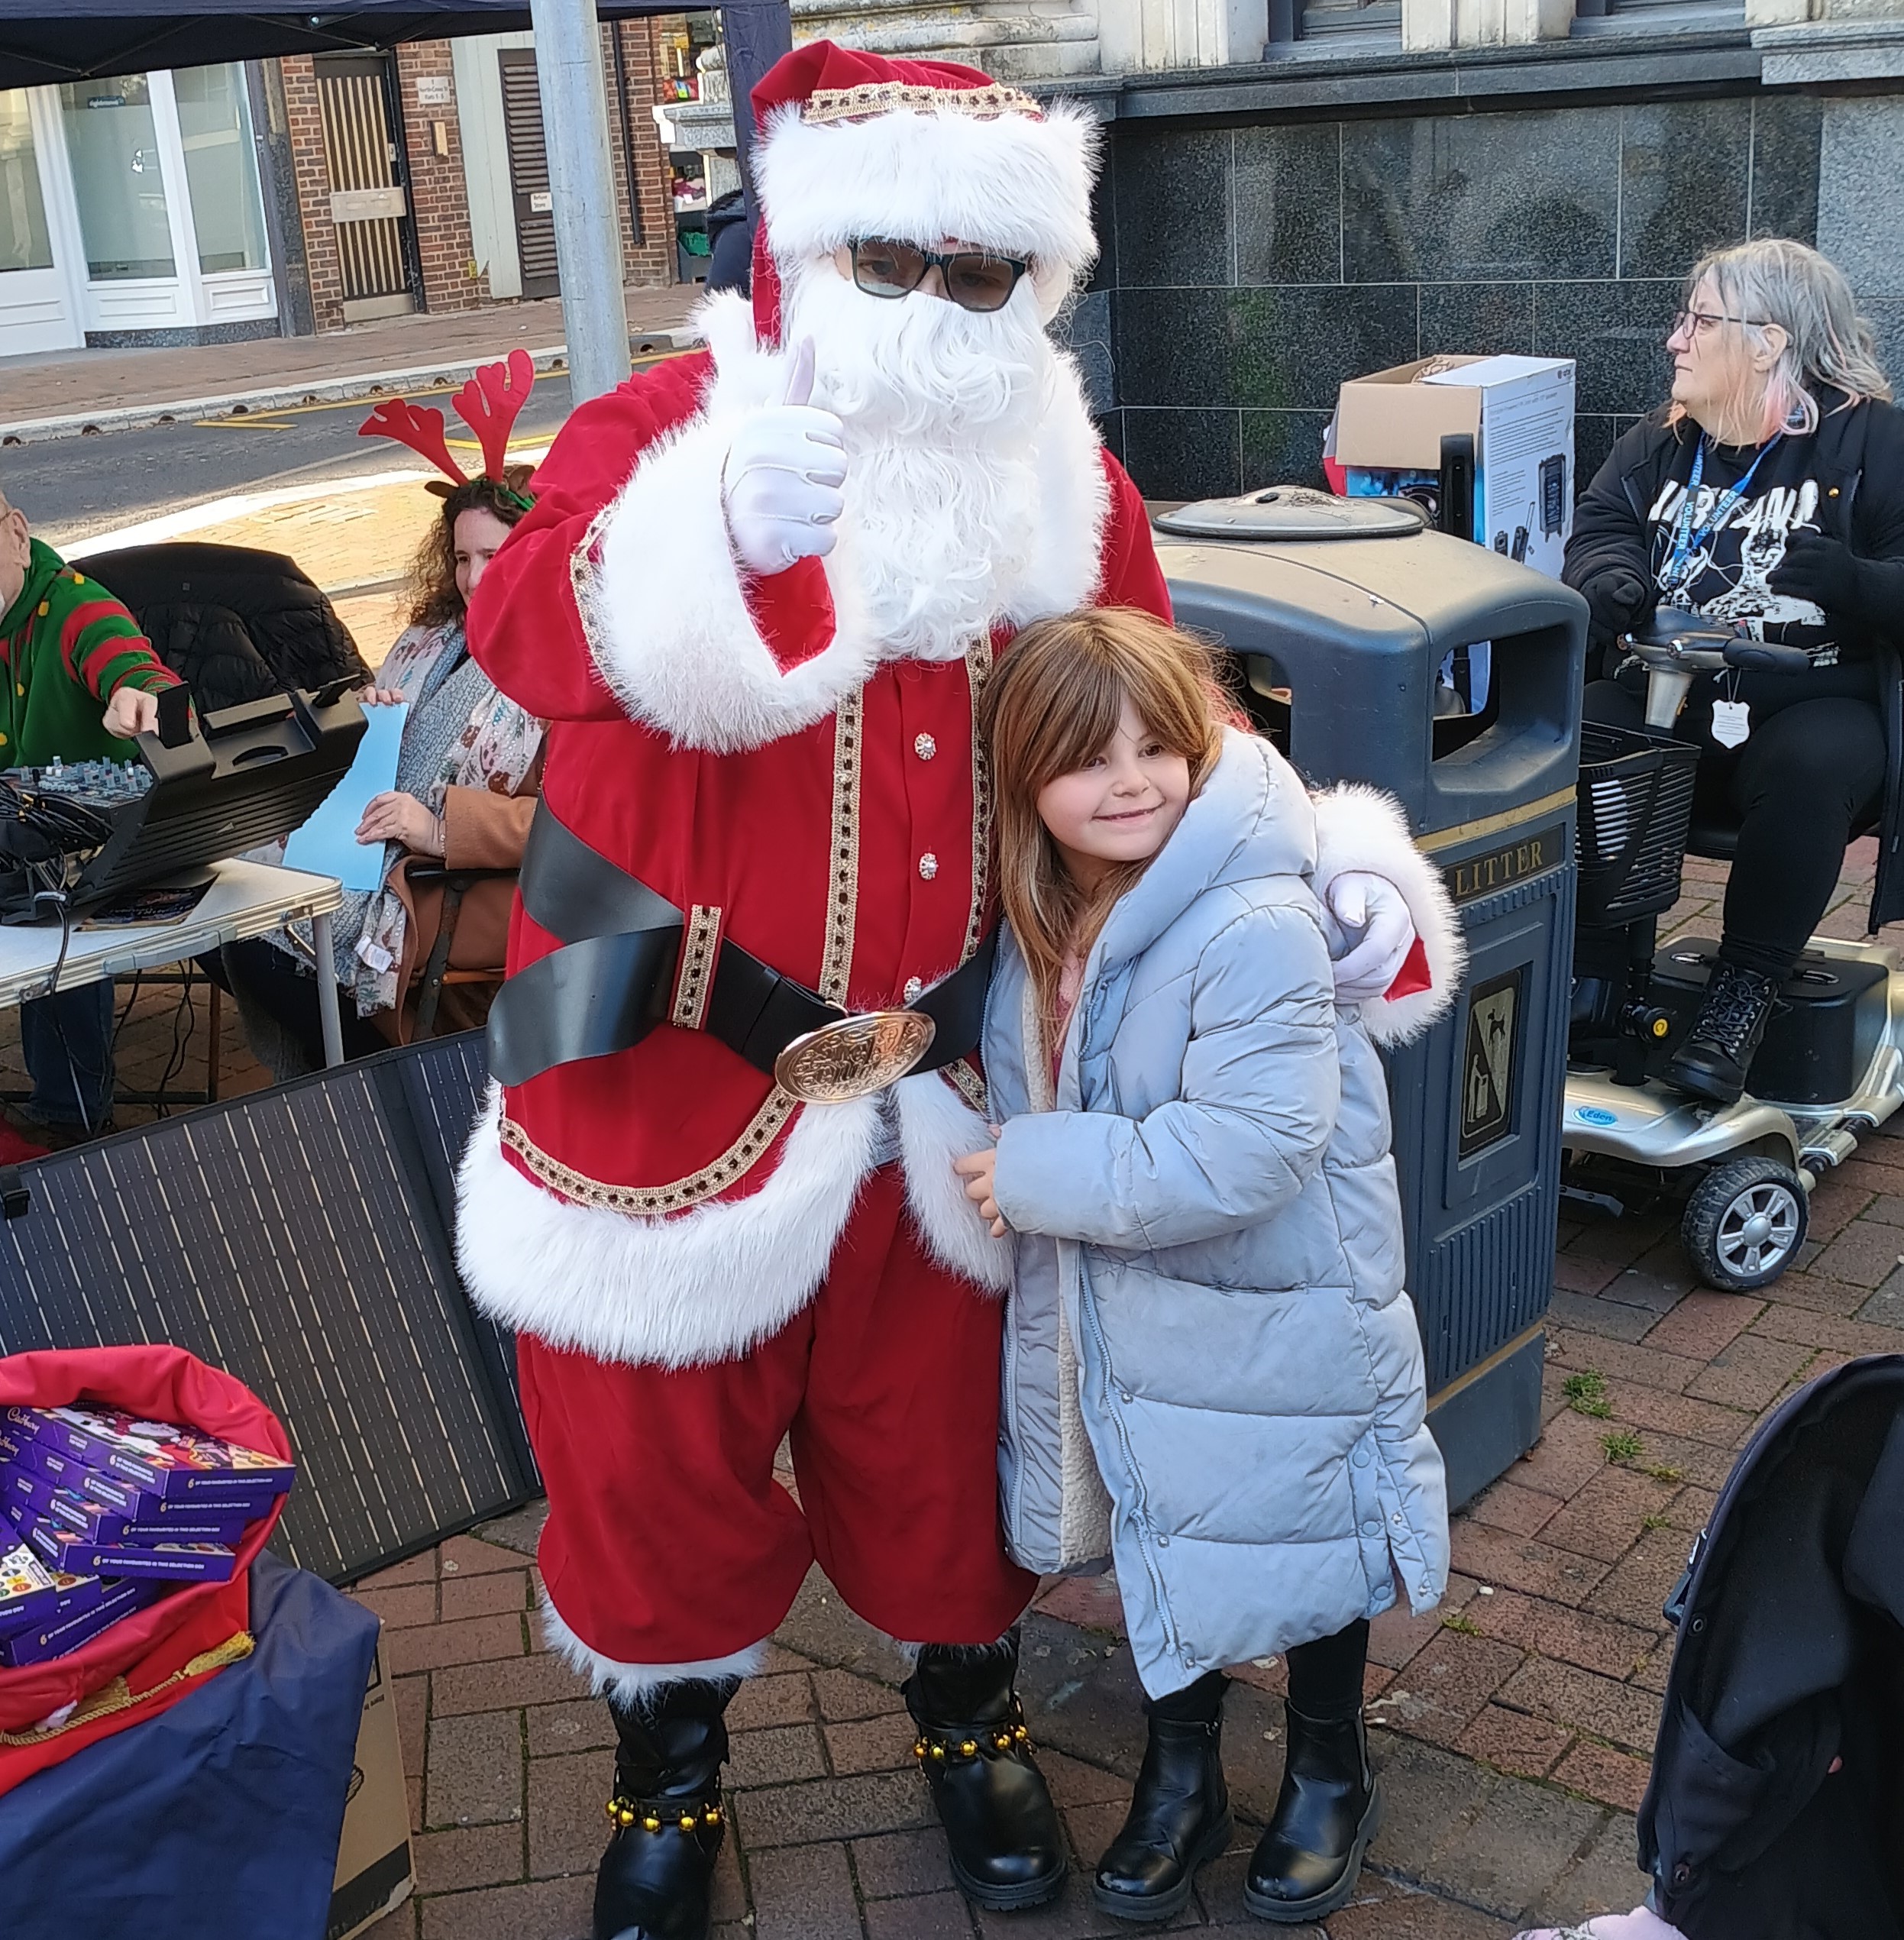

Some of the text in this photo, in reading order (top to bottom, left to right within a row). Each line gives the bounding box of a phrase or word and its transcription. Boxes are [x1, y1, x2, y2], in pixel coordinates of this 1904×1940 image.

[1699, 490, 1740, 537] VOLUNTEER
[1676, 501, 1695, 550] VOLUNTEER
[1455, 841, 1543, 897] LITTER
[1586, 1110, 1612, 1122] Eden
[7, 1407, 40, 1435] Cadbury
[110, 1454, 117, 1466] 6
[84, 1477, 91, 1489] 6
[188, 1478, 195, 1489] 6
[160, 1502, 167, 1512] 6
[122, 1525, 130, 1535] 6
[92, 1555, 102, 1566] 6
[40, 1634, 47, 1645] 6
